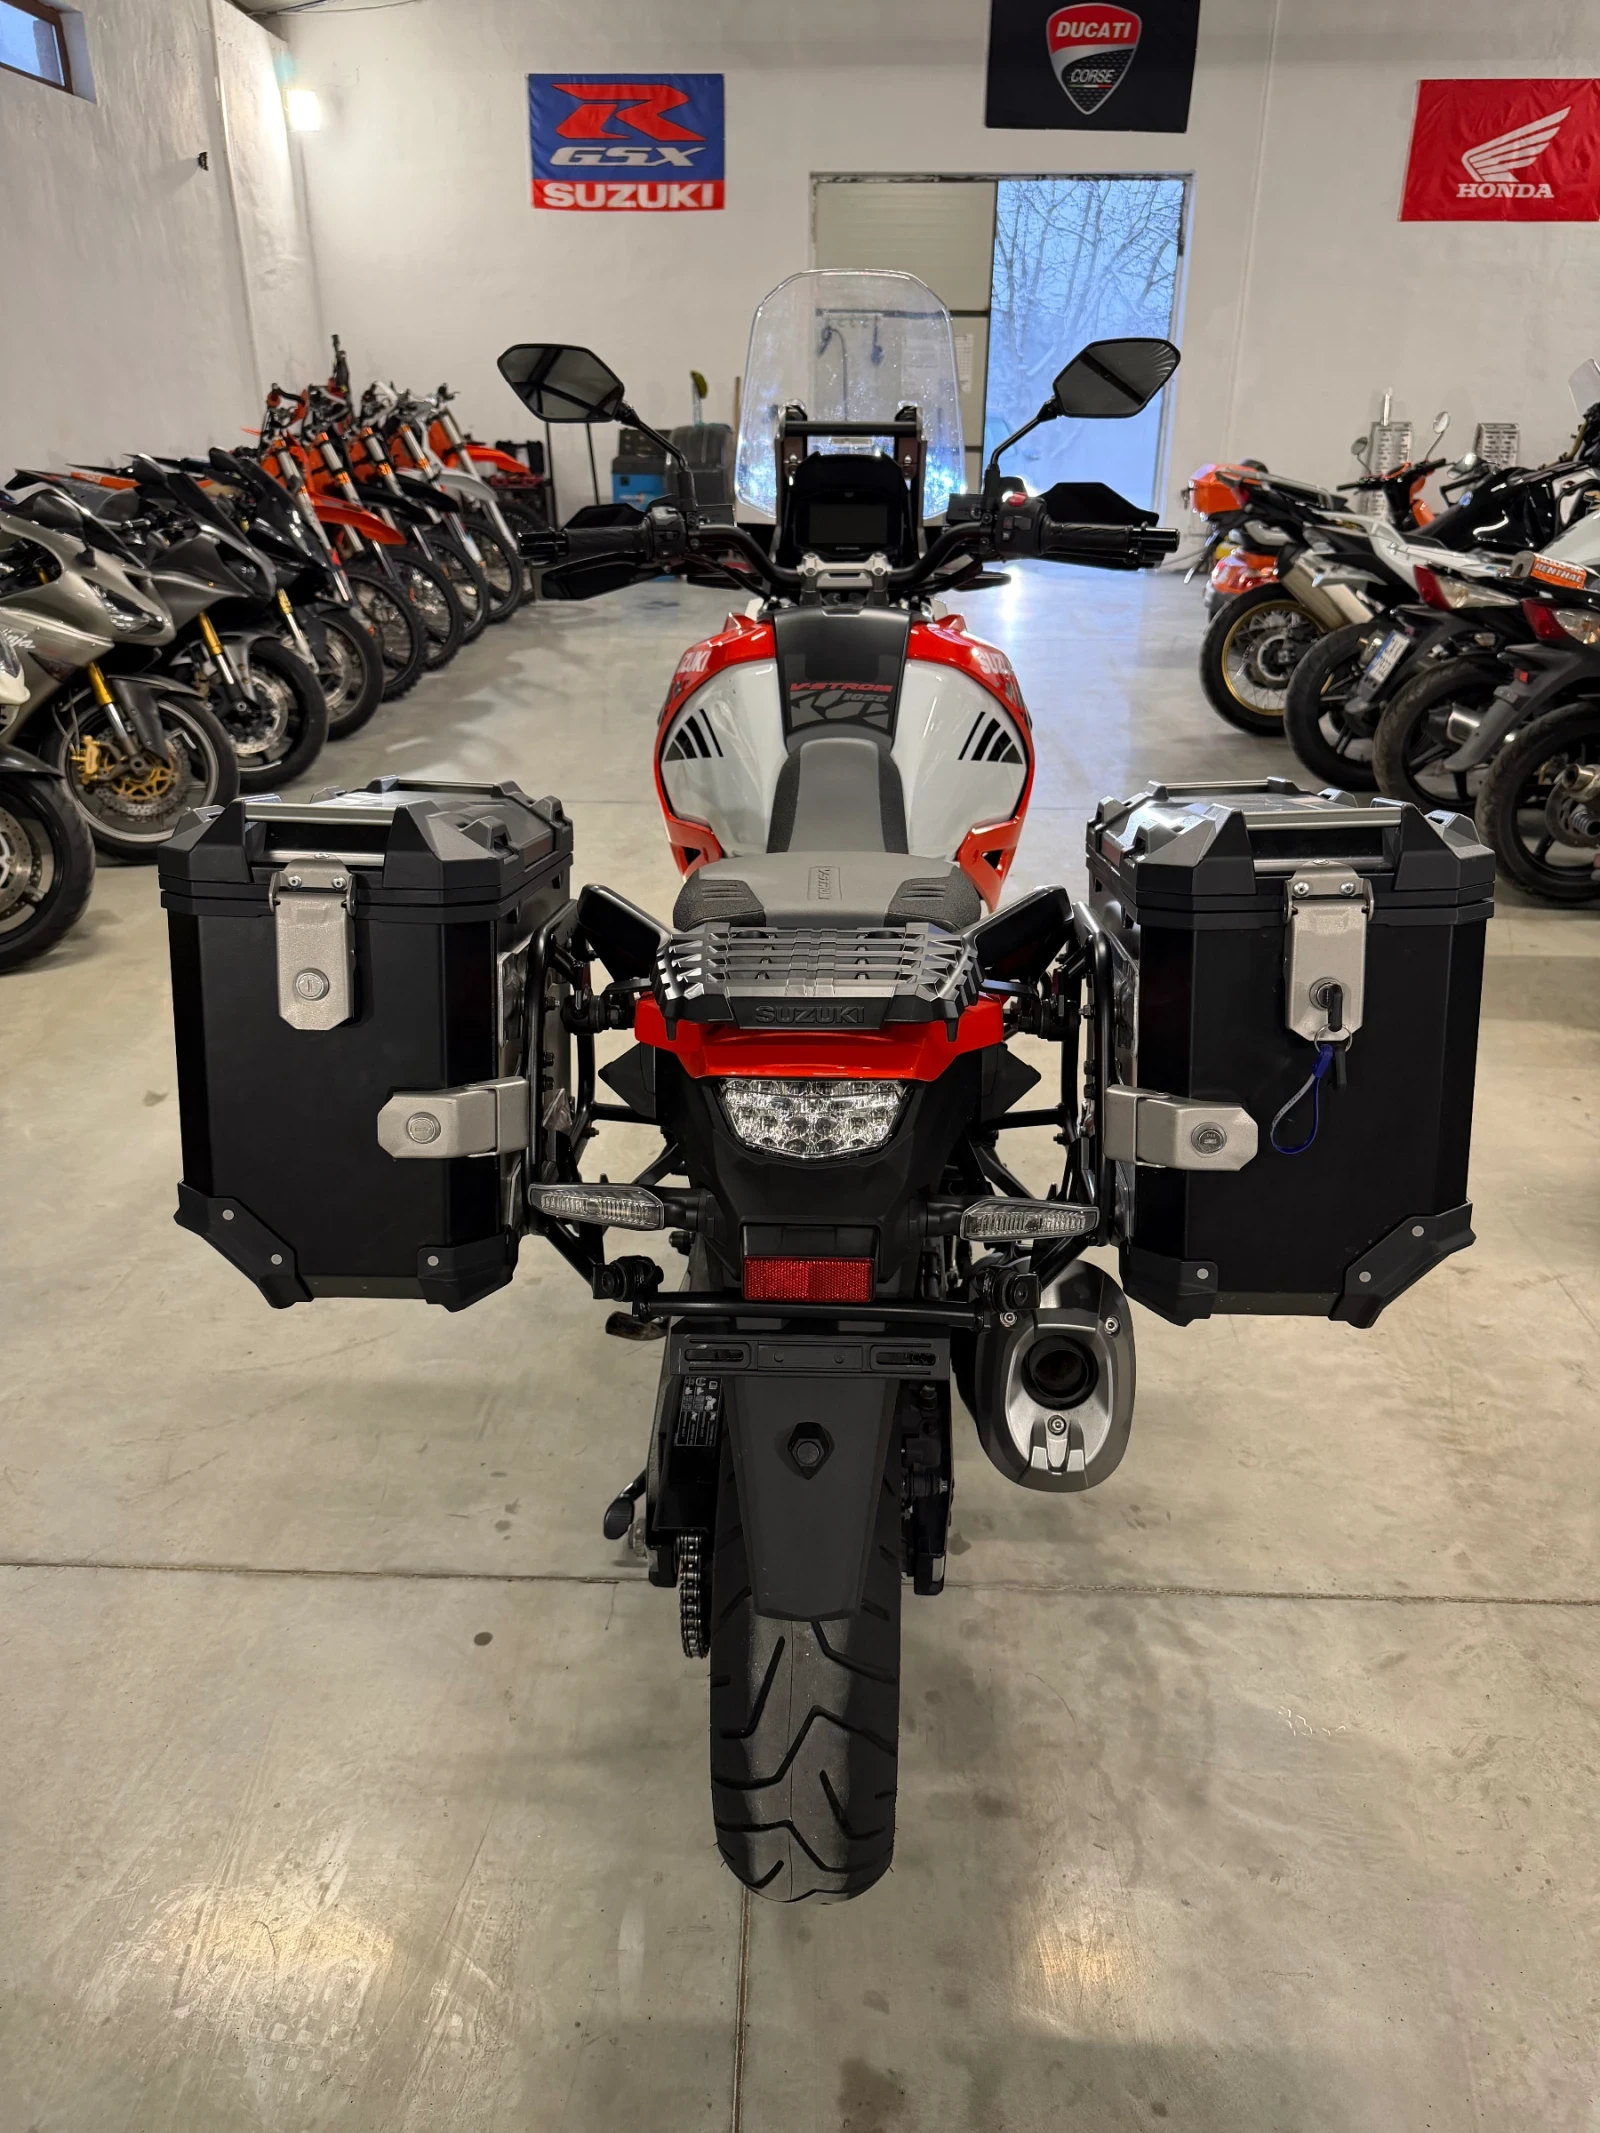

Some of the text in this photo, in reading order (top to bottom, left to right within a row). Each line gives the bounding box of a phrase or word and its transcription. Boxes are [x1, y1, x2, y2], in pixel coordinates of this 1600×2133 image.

[1056, 21, 1132, 38] DUCATI
[1070, 68, 1115, 83] CORSE
[550, 146, 706, 167] GSX
[543, 182, 714, 208] SUZUKI
[1456, 183, 1554, 198] HONDA
[1535, 562, 1582, 583] RENTHAL
[789, 682, 893, 692] V-STROM
[841, 693, 889, 702] 1050
[755, 1005, 865, 1024] SUZUKI
